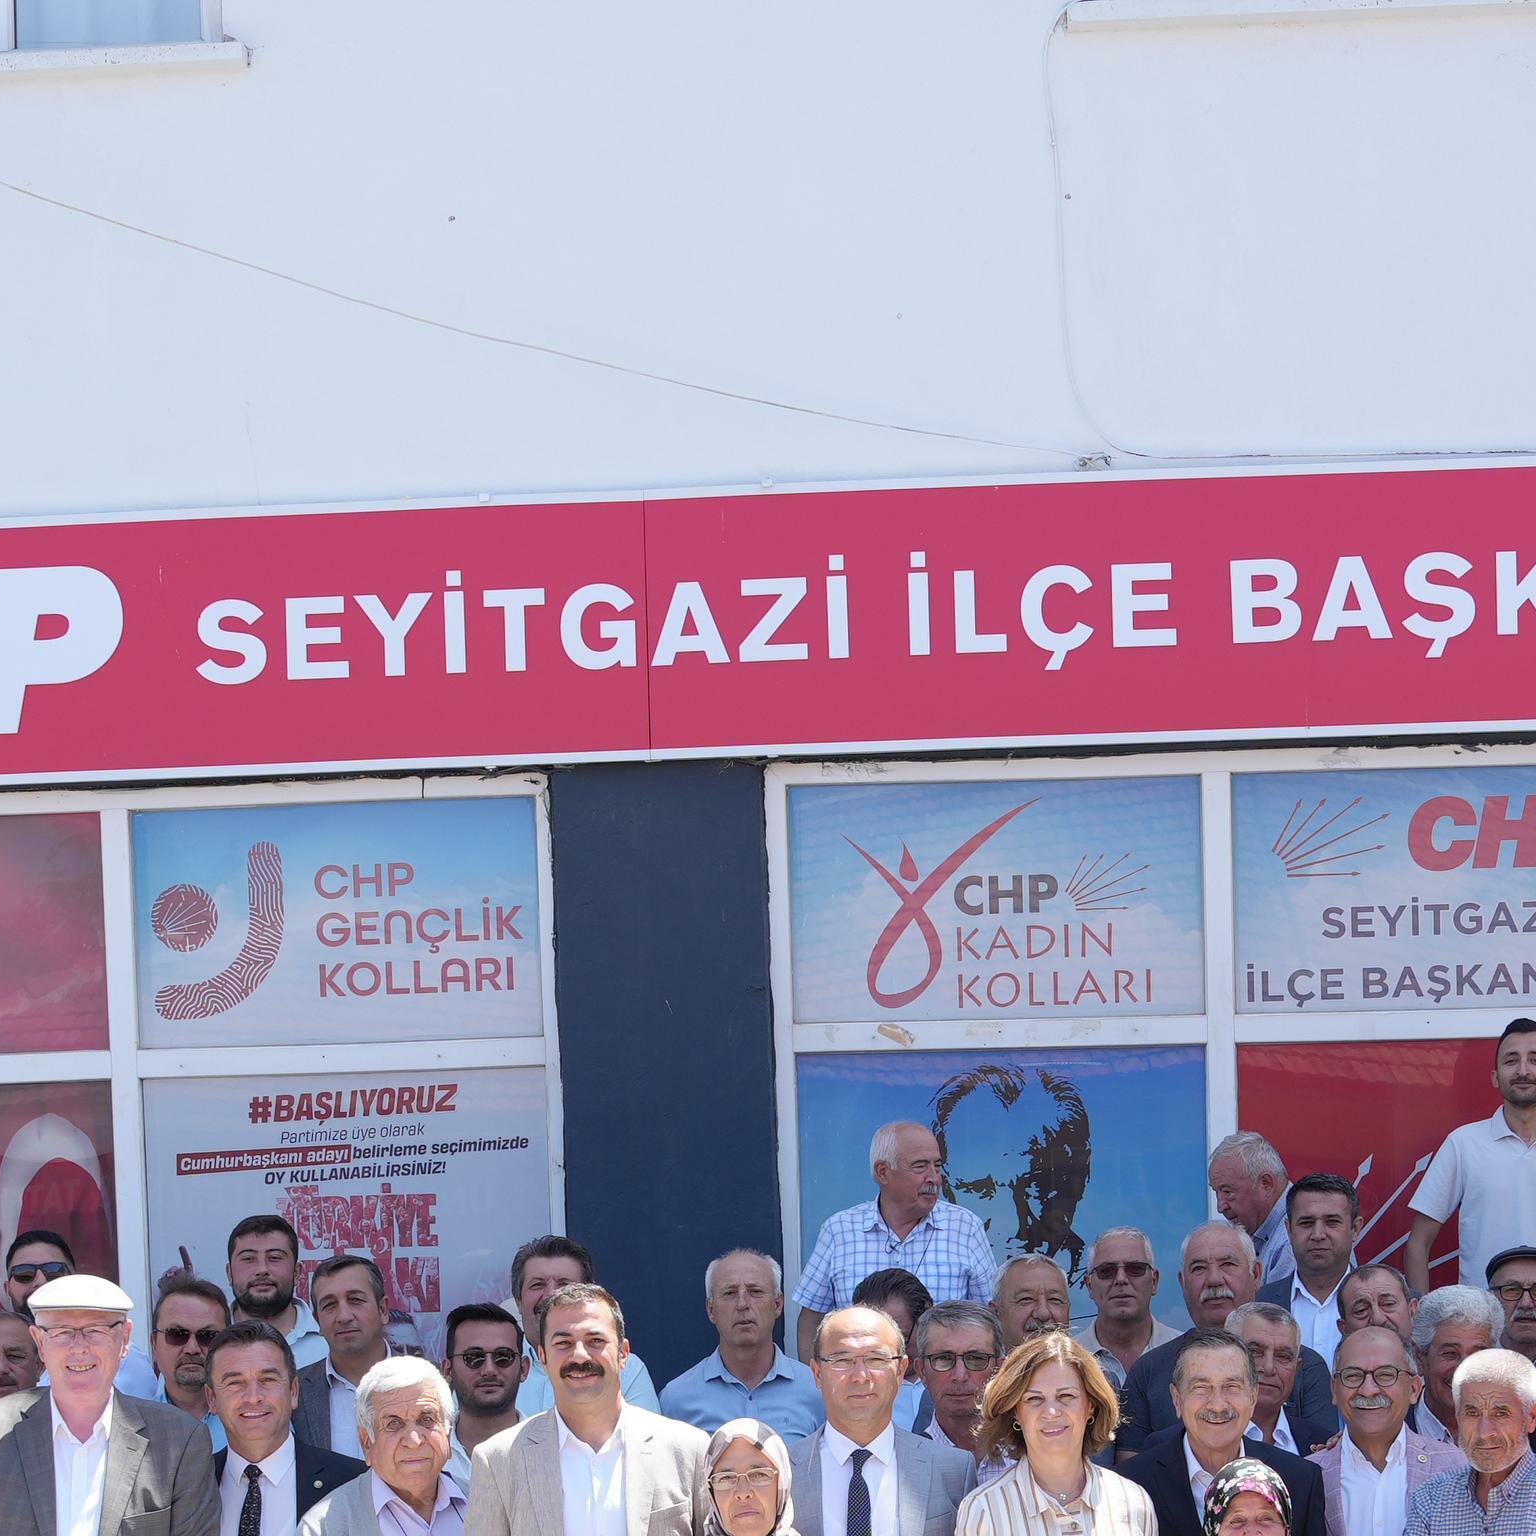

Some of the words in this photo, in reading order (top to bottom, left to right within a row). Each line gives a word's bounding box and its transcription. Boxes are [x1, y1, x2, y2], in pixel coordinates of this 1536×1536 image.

[195, 553, 851, 685] SEYİTGAZİ
[908, 550, 1177, 672] İLÇE
[314, 862, 415, 900] CHP
[953, 874, 1060, 916] CHP
[315, 896, 524, 955] GENÇLİK
[956, 922, 1114, 962] KADIN
[318, 956, 515, 998] KOLLARI
[957, 968, 1153, 1009] KOLLARI
[1246, 962, 1345, 1007] İLÇE
[248, 1083, 459, 1126] #BAŞLIYORUZ
[180, 1150, 303, 1172] Cumhurbaşkanı
[306, 1147, 349, 1166] adayı
[353, 1142, 427, 1160] belirleme
[431, 1136, 529, 1157] seçimimizde
[280, 1126, 348, 1145] Partimize
[352, 1126, 376, 1143] üye
[380, 1122, 425, 1139] olarak
[264, 1170, 285, 1185] OY
[290, 1161, 447, 1184] KULLANABİLİRSİNİZ!
